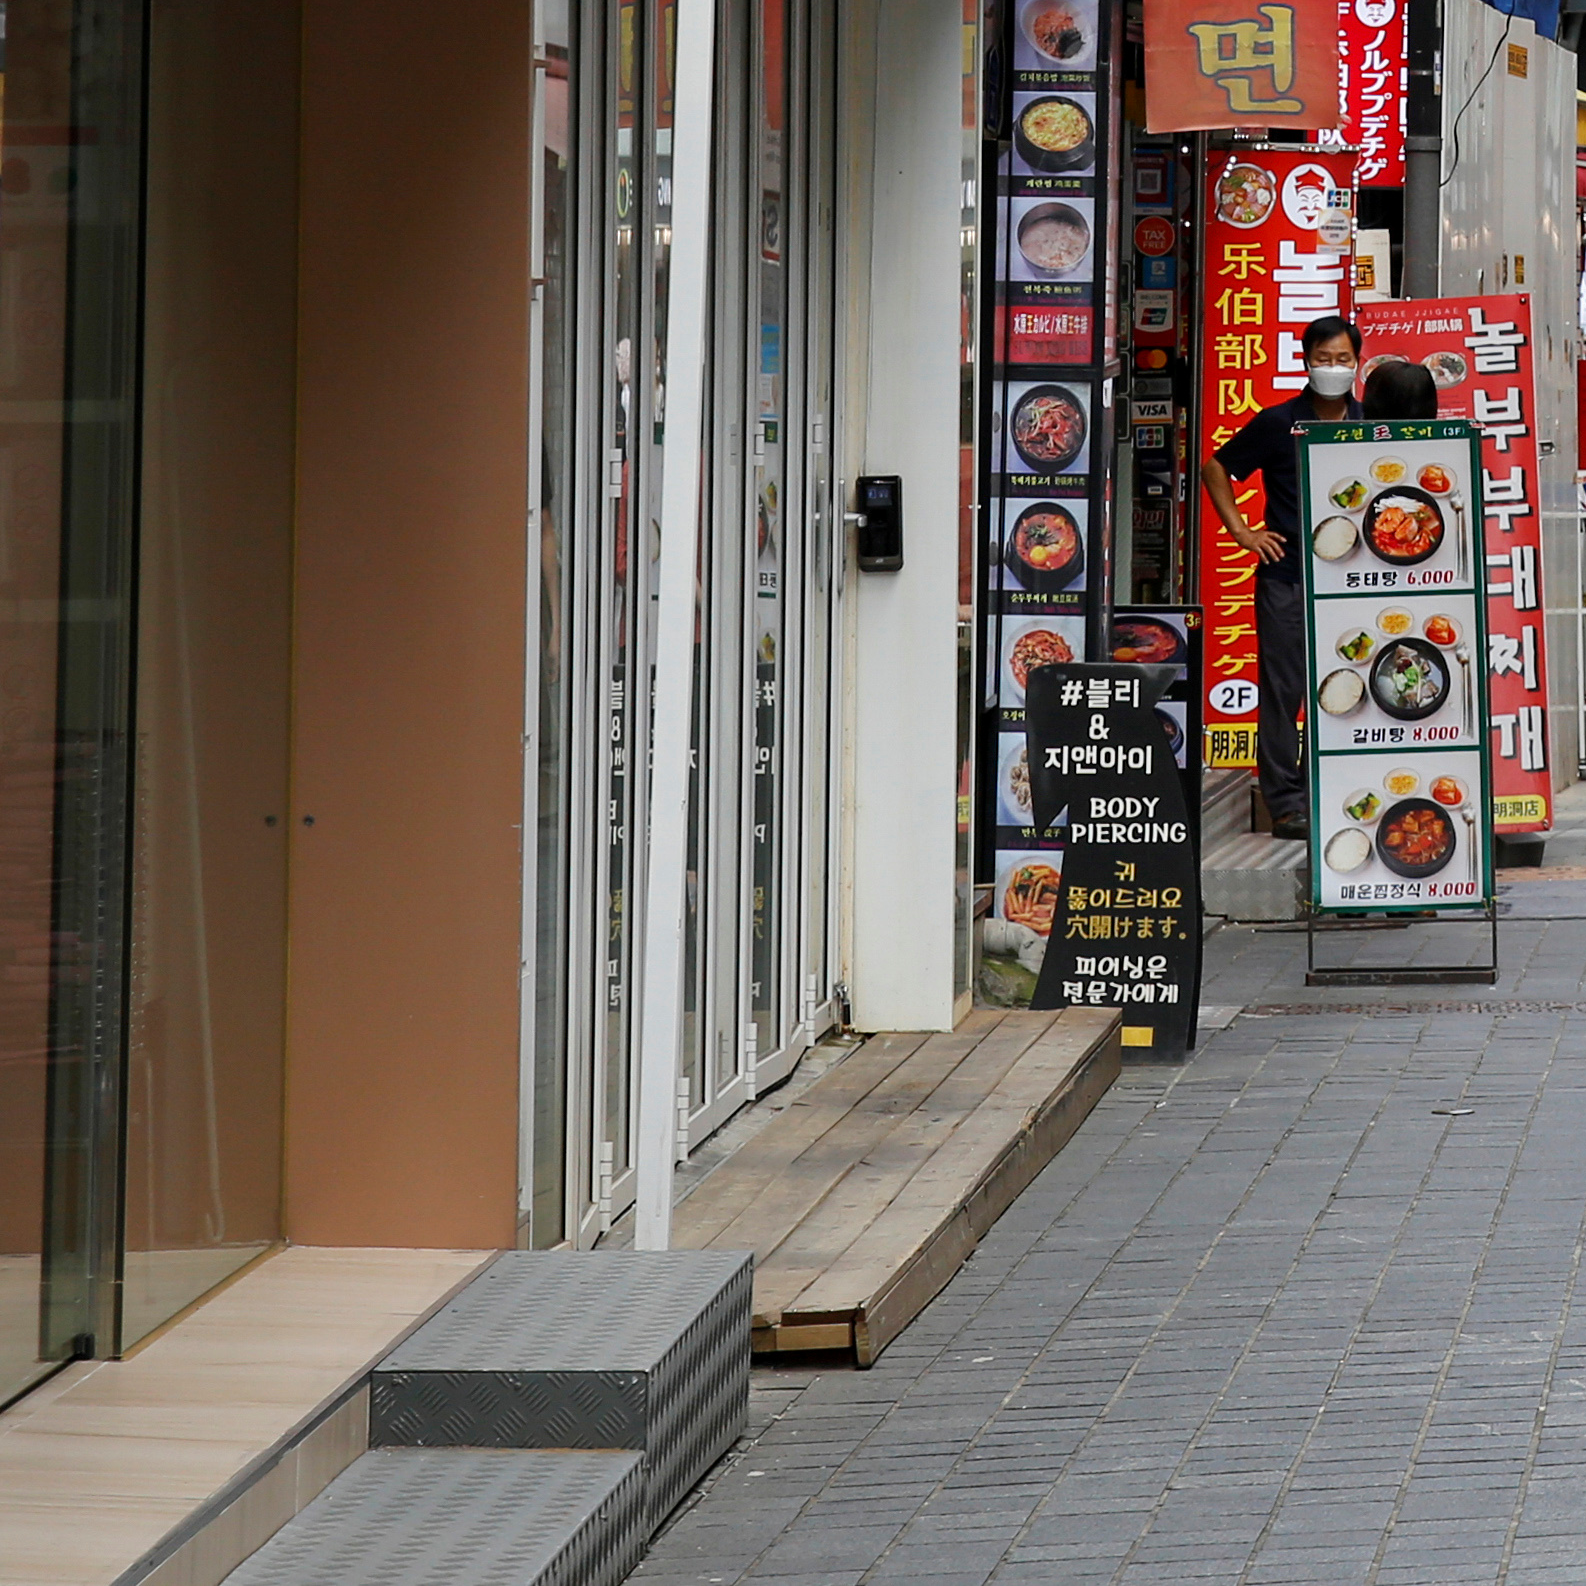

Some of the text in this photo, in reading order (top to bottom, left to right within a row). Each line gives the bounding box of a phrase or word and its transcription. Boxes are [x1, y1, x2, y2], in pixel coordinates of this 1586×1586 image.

[1366, 307, 1460, 319] BUDAE JJIGAE
[1137, 404, 1168, 417] VISA
[1345, 568, 1455, 588] 동태탕 6,000
[1060, 678, 1140, 709] #블리
[1221, 687, 1253, 709] 2F
[1087, 713, 1109, 740] &
[1351, 725, 1460, 745] 갈비탕 8,000
[1044, 744, 1153, 775] 지앤아이
[1089, 796, 1160, 819] BODY
[1071, 822, 1188, 844] PIERCING
[1114, 860, 1136, 882] 귀
[1426, 880, 1476, 899] 8,000
[1064, 914, 1188, 941] 穴開けます。
[1074, 955, 1168, 979] 피어싱은
[1061, 980, 1180, 1005] 전문가에게
